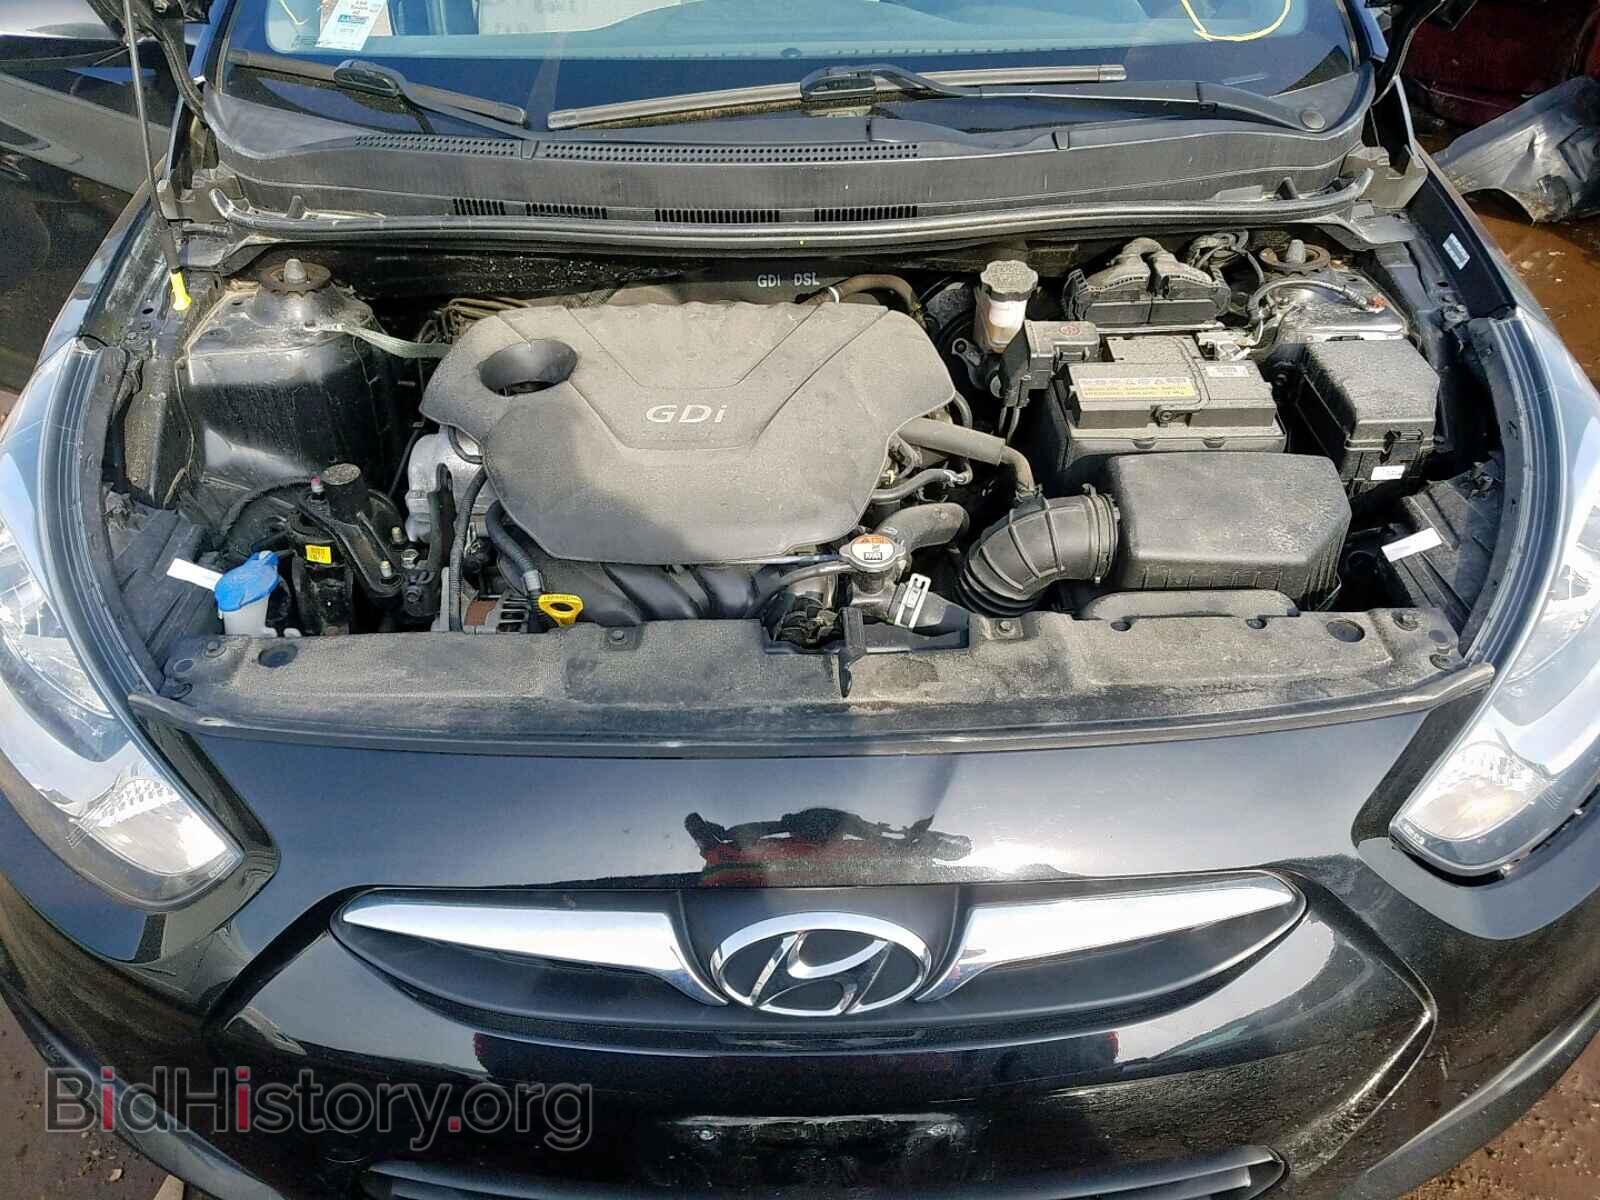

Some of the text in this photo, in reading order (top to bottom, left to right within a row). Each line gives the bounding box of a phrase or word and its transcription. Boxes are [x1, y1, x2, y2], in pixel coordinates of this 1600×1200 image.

[757, 272, 821, 288] GDI DSL
[646, 404, 728, 423] GDi
